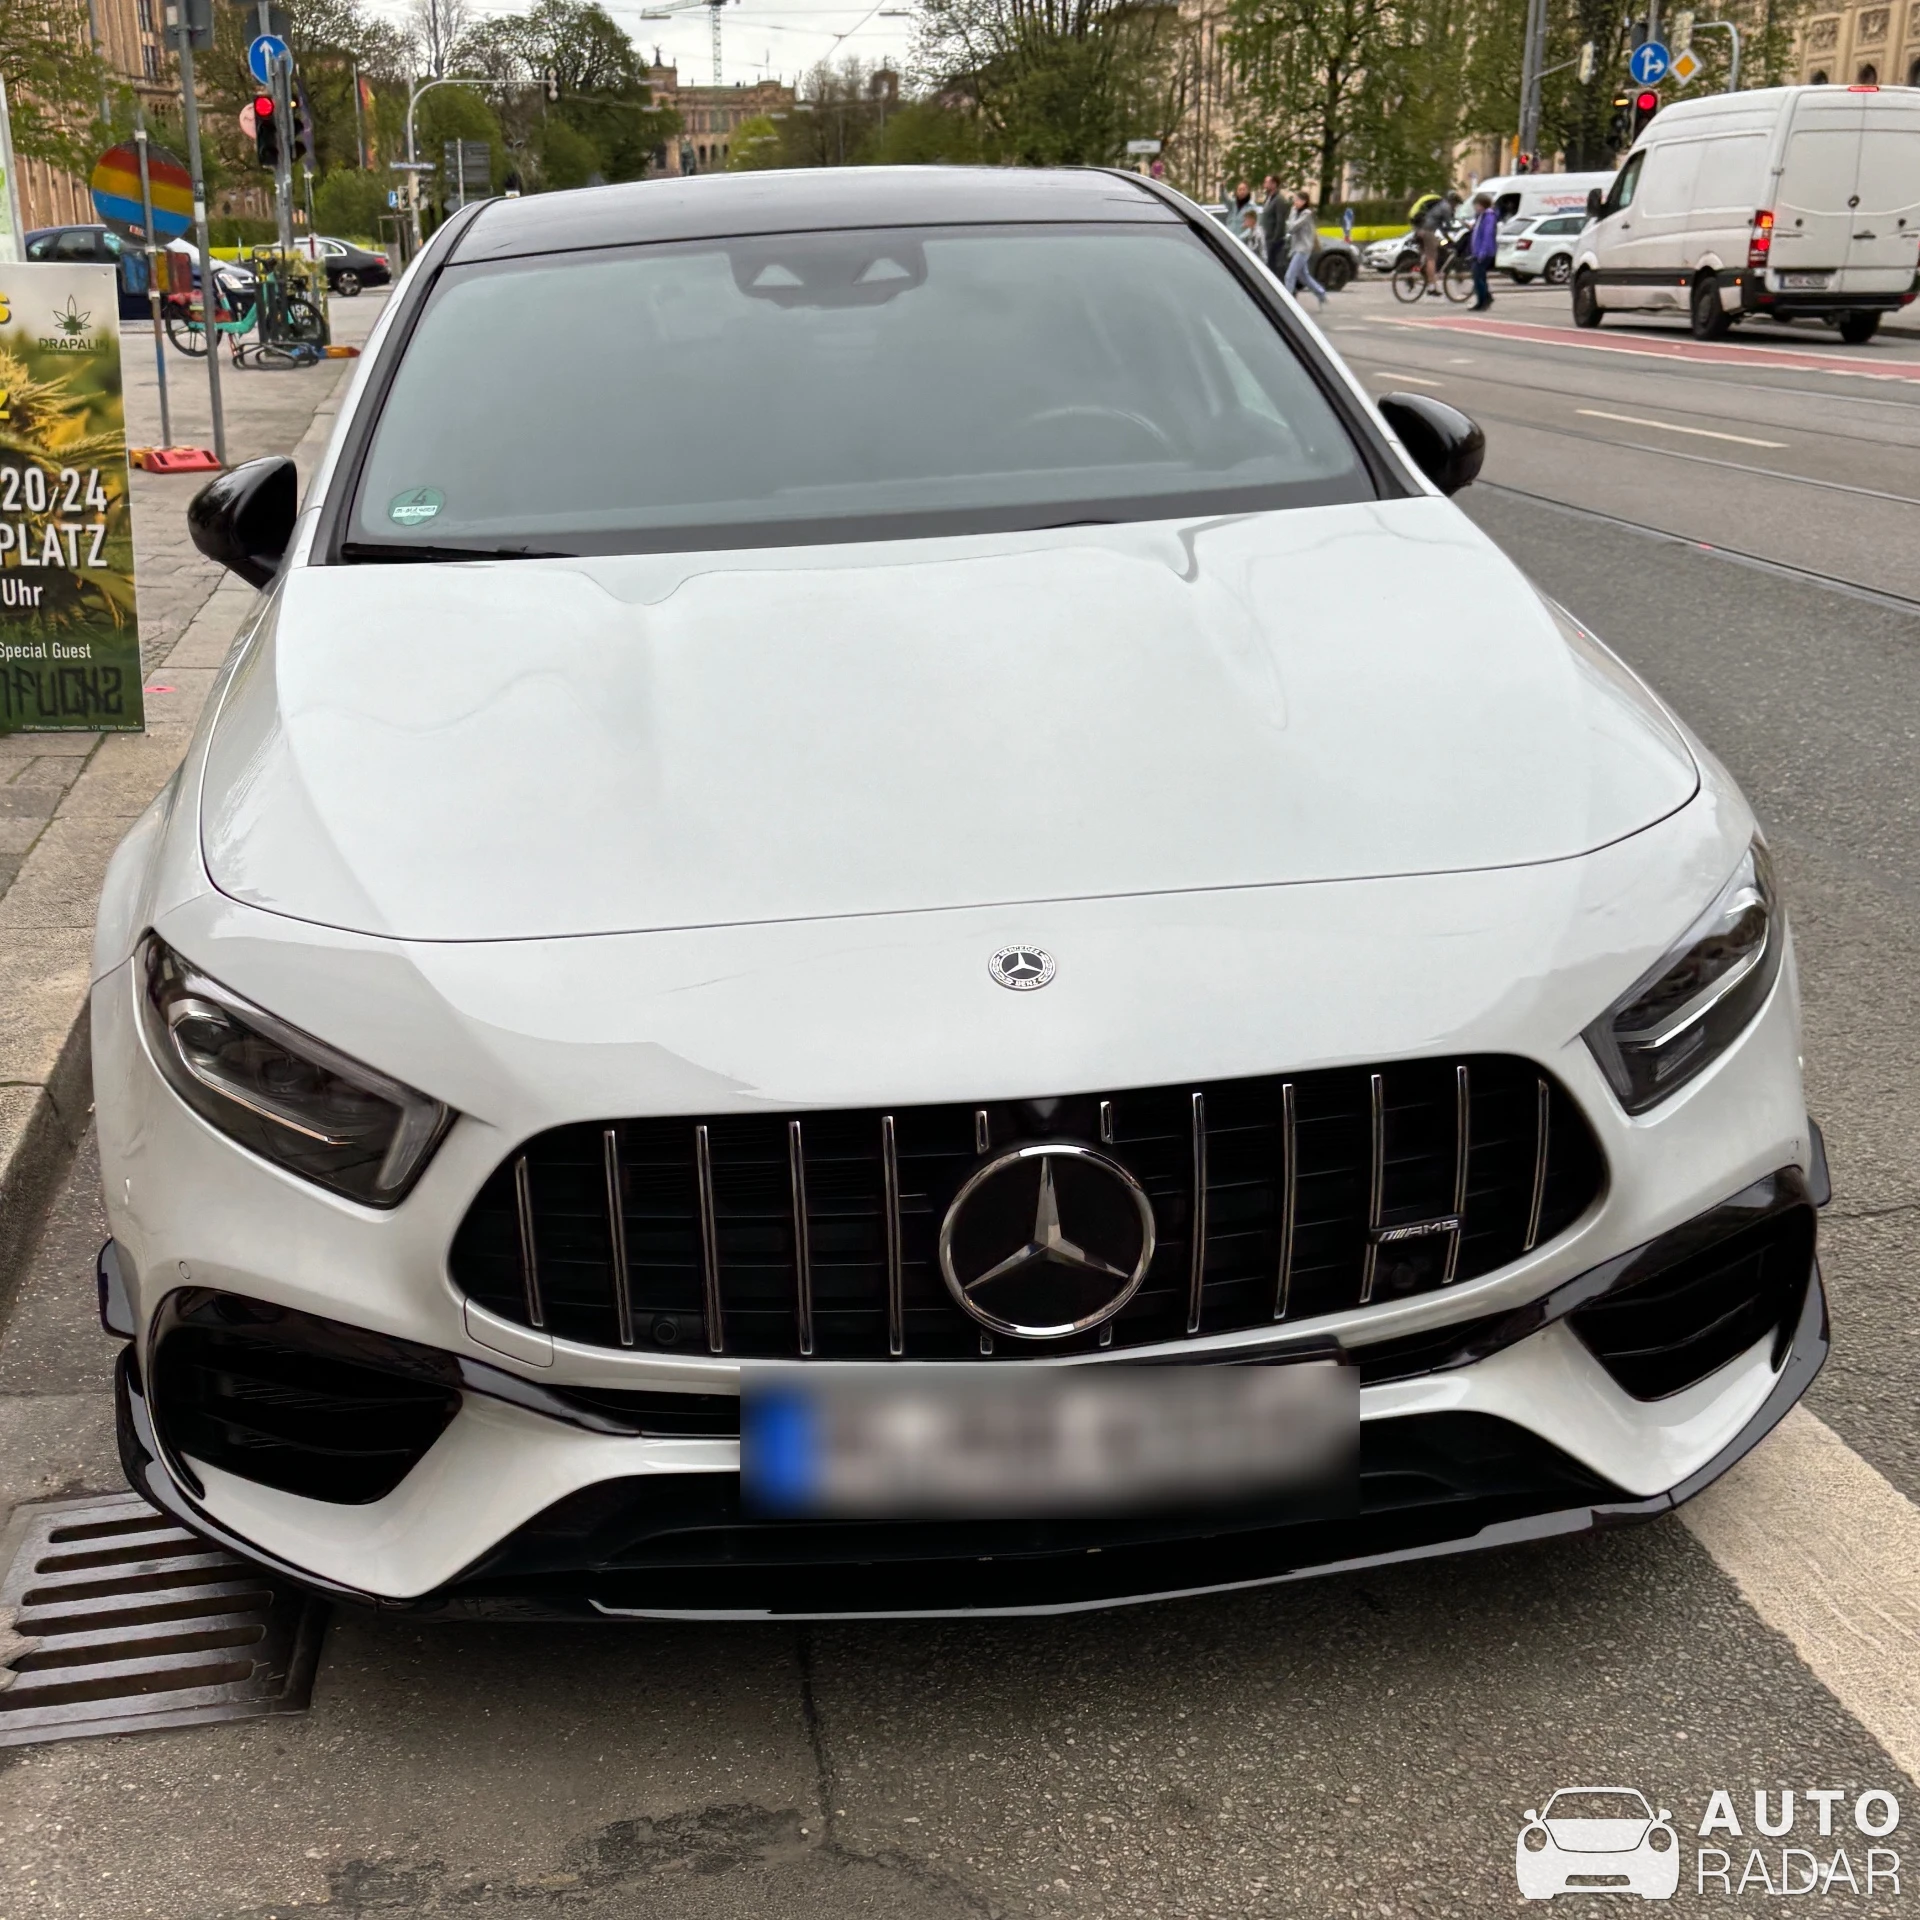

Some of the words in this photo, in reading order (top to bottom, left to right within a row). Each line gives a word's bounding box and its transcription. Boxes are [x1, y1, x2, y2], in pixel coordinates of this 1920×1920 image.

[411, 488, 428, 506] 4
[2, 578, 43, 607] Uhr
[0, 642, 47, 662] Special
[52, 642, 92, 659] Guest
